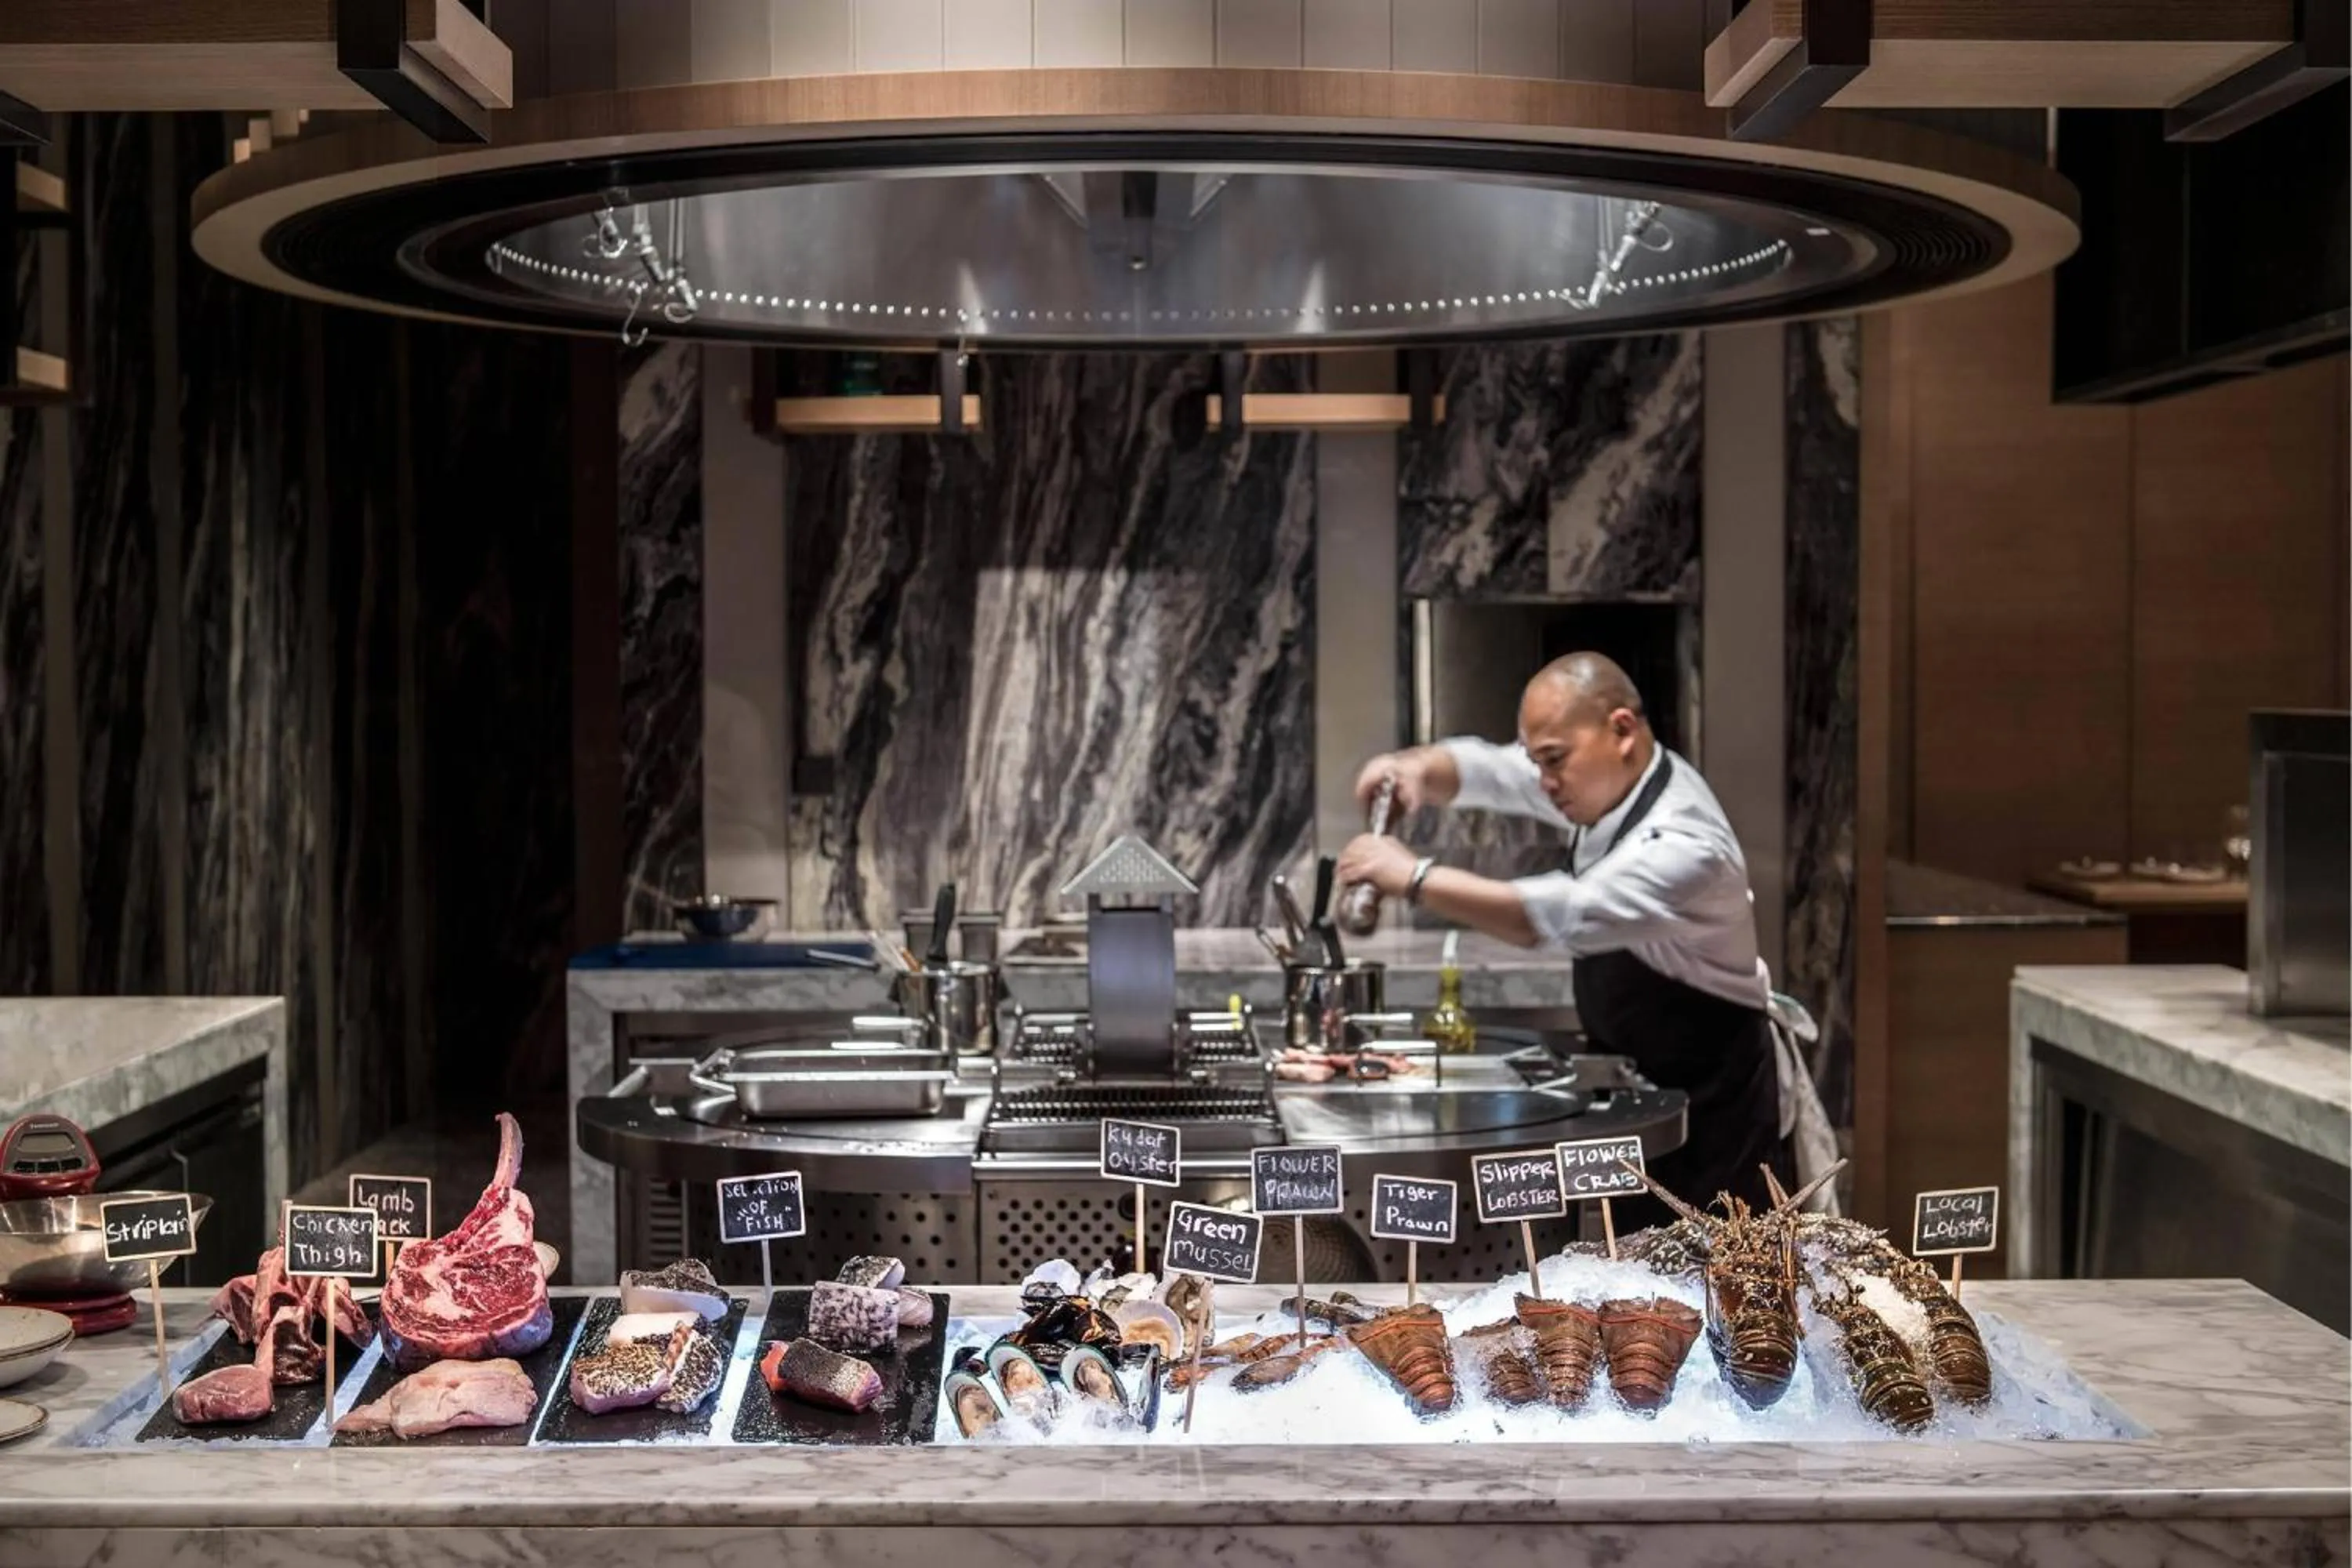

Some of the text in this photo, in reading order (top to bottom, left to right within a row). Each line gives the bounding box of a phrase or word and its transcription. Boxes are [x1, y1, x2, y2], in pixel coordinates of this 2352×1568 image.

[1382, 1184, 1439, 1201] Tiger
[377, 1217, 411, 1235] ack
[1177, 1209, 1247, 1244] Green
[1386, 1206, 1448, 1232] Prawn
